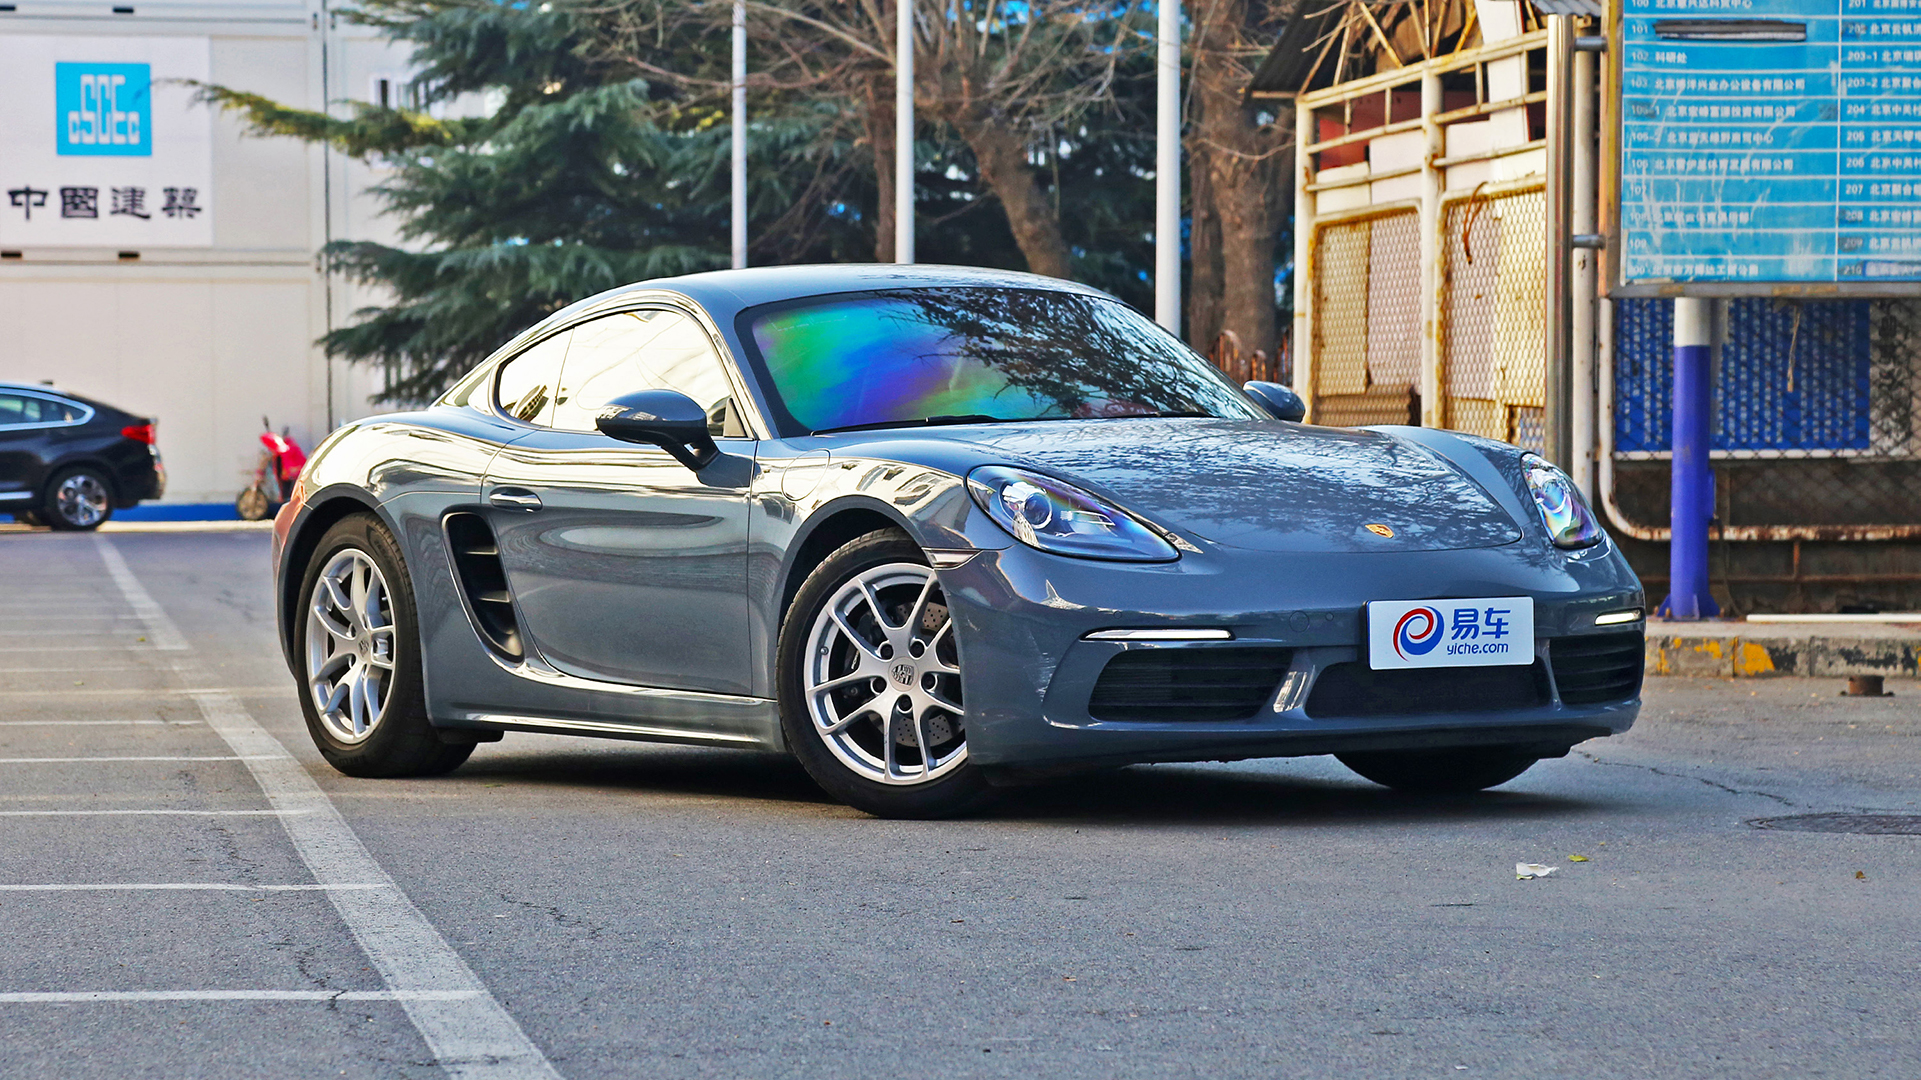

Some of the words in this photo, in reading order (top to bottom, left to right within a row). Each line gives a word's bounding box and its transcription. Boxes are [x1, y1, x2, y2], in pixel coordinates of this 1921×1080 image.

[1631, 26, 1648, 34] 101
[1631, 51, 1649, 62] 102
[1847, 50, 1878, 62] 203-1
[1631, 77, 1648, 88] 103
[1847, 77, 1878, 88] 203-2
[1846, 104, 1866, 115] 204
[1846, 130, 1865, 142] 205
[1846, 157, 1865, 168] 206
[1845, 183, 1864, 195] 207
[1451, 607, 1511, 640] 易车
[1447, 642, 1509, 655] yiche.com
